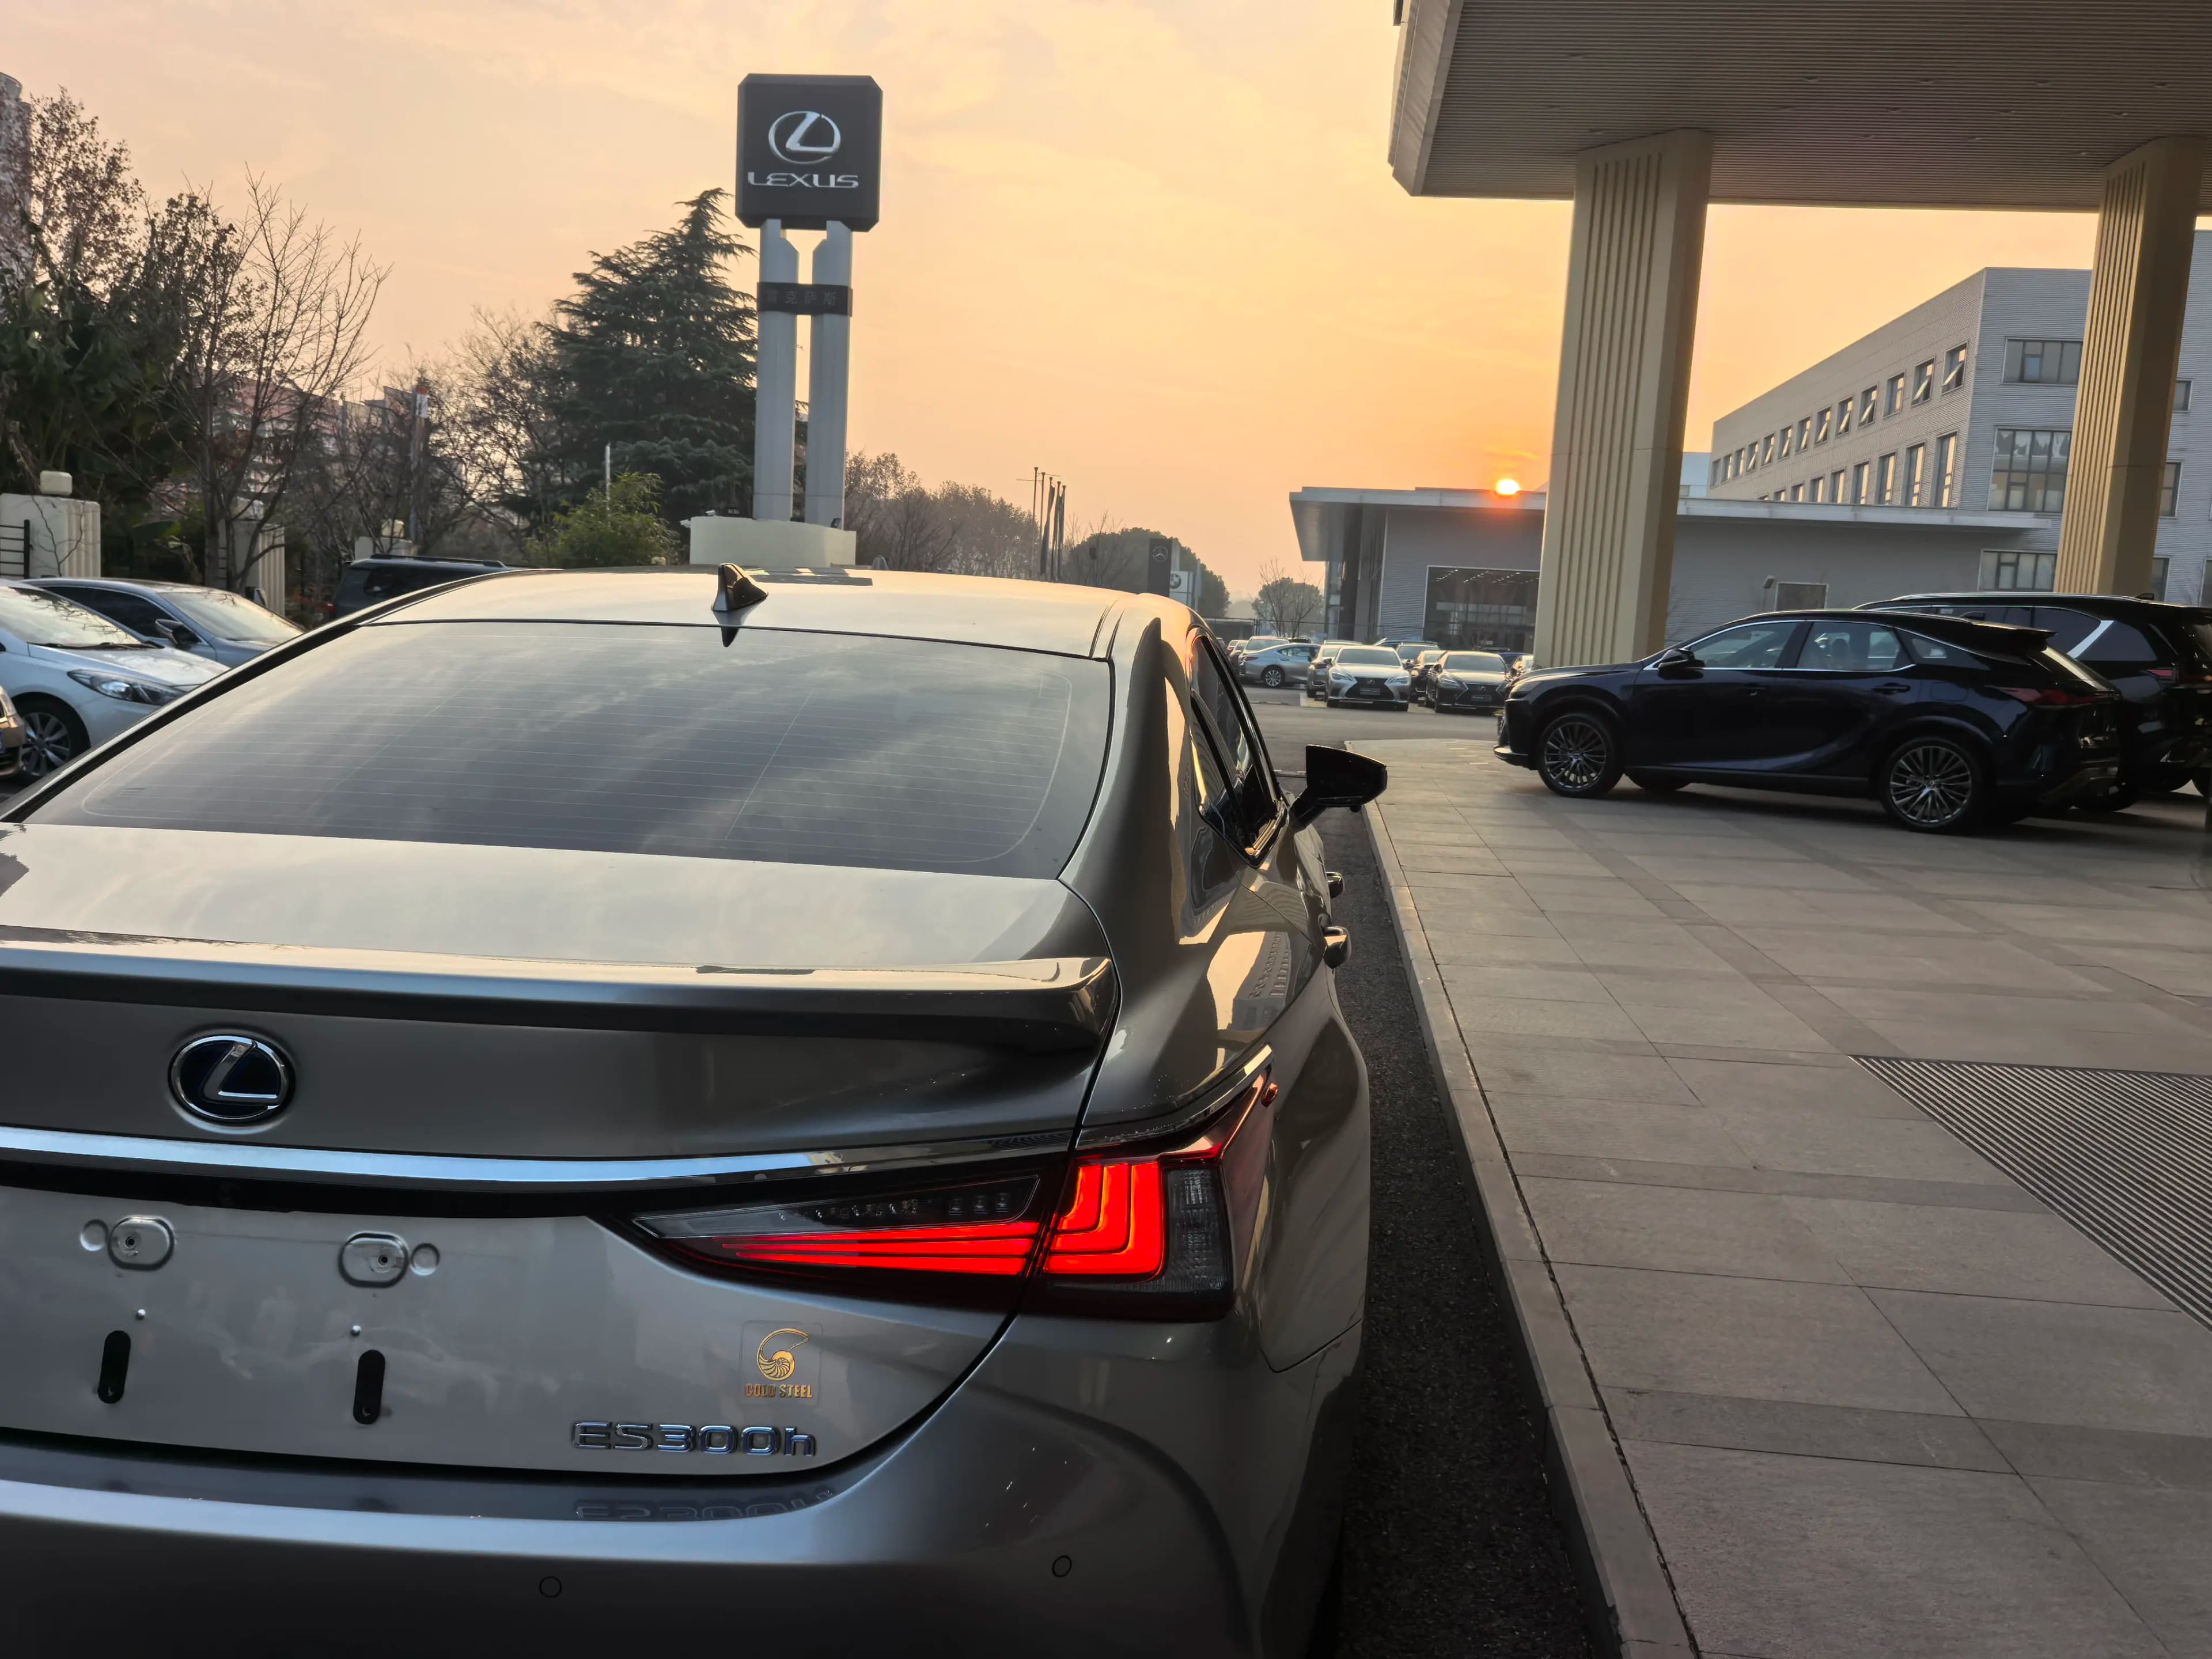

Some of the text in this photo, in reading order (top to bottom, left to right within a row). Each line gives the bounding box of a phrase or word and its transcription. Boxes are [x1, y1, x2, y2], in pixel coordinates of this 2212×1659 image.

[747, 171, 859, 189] LEXUS
[779, 1384, 813, 1397] STEEL
[573, 1422, 816, 1457] ES300h
